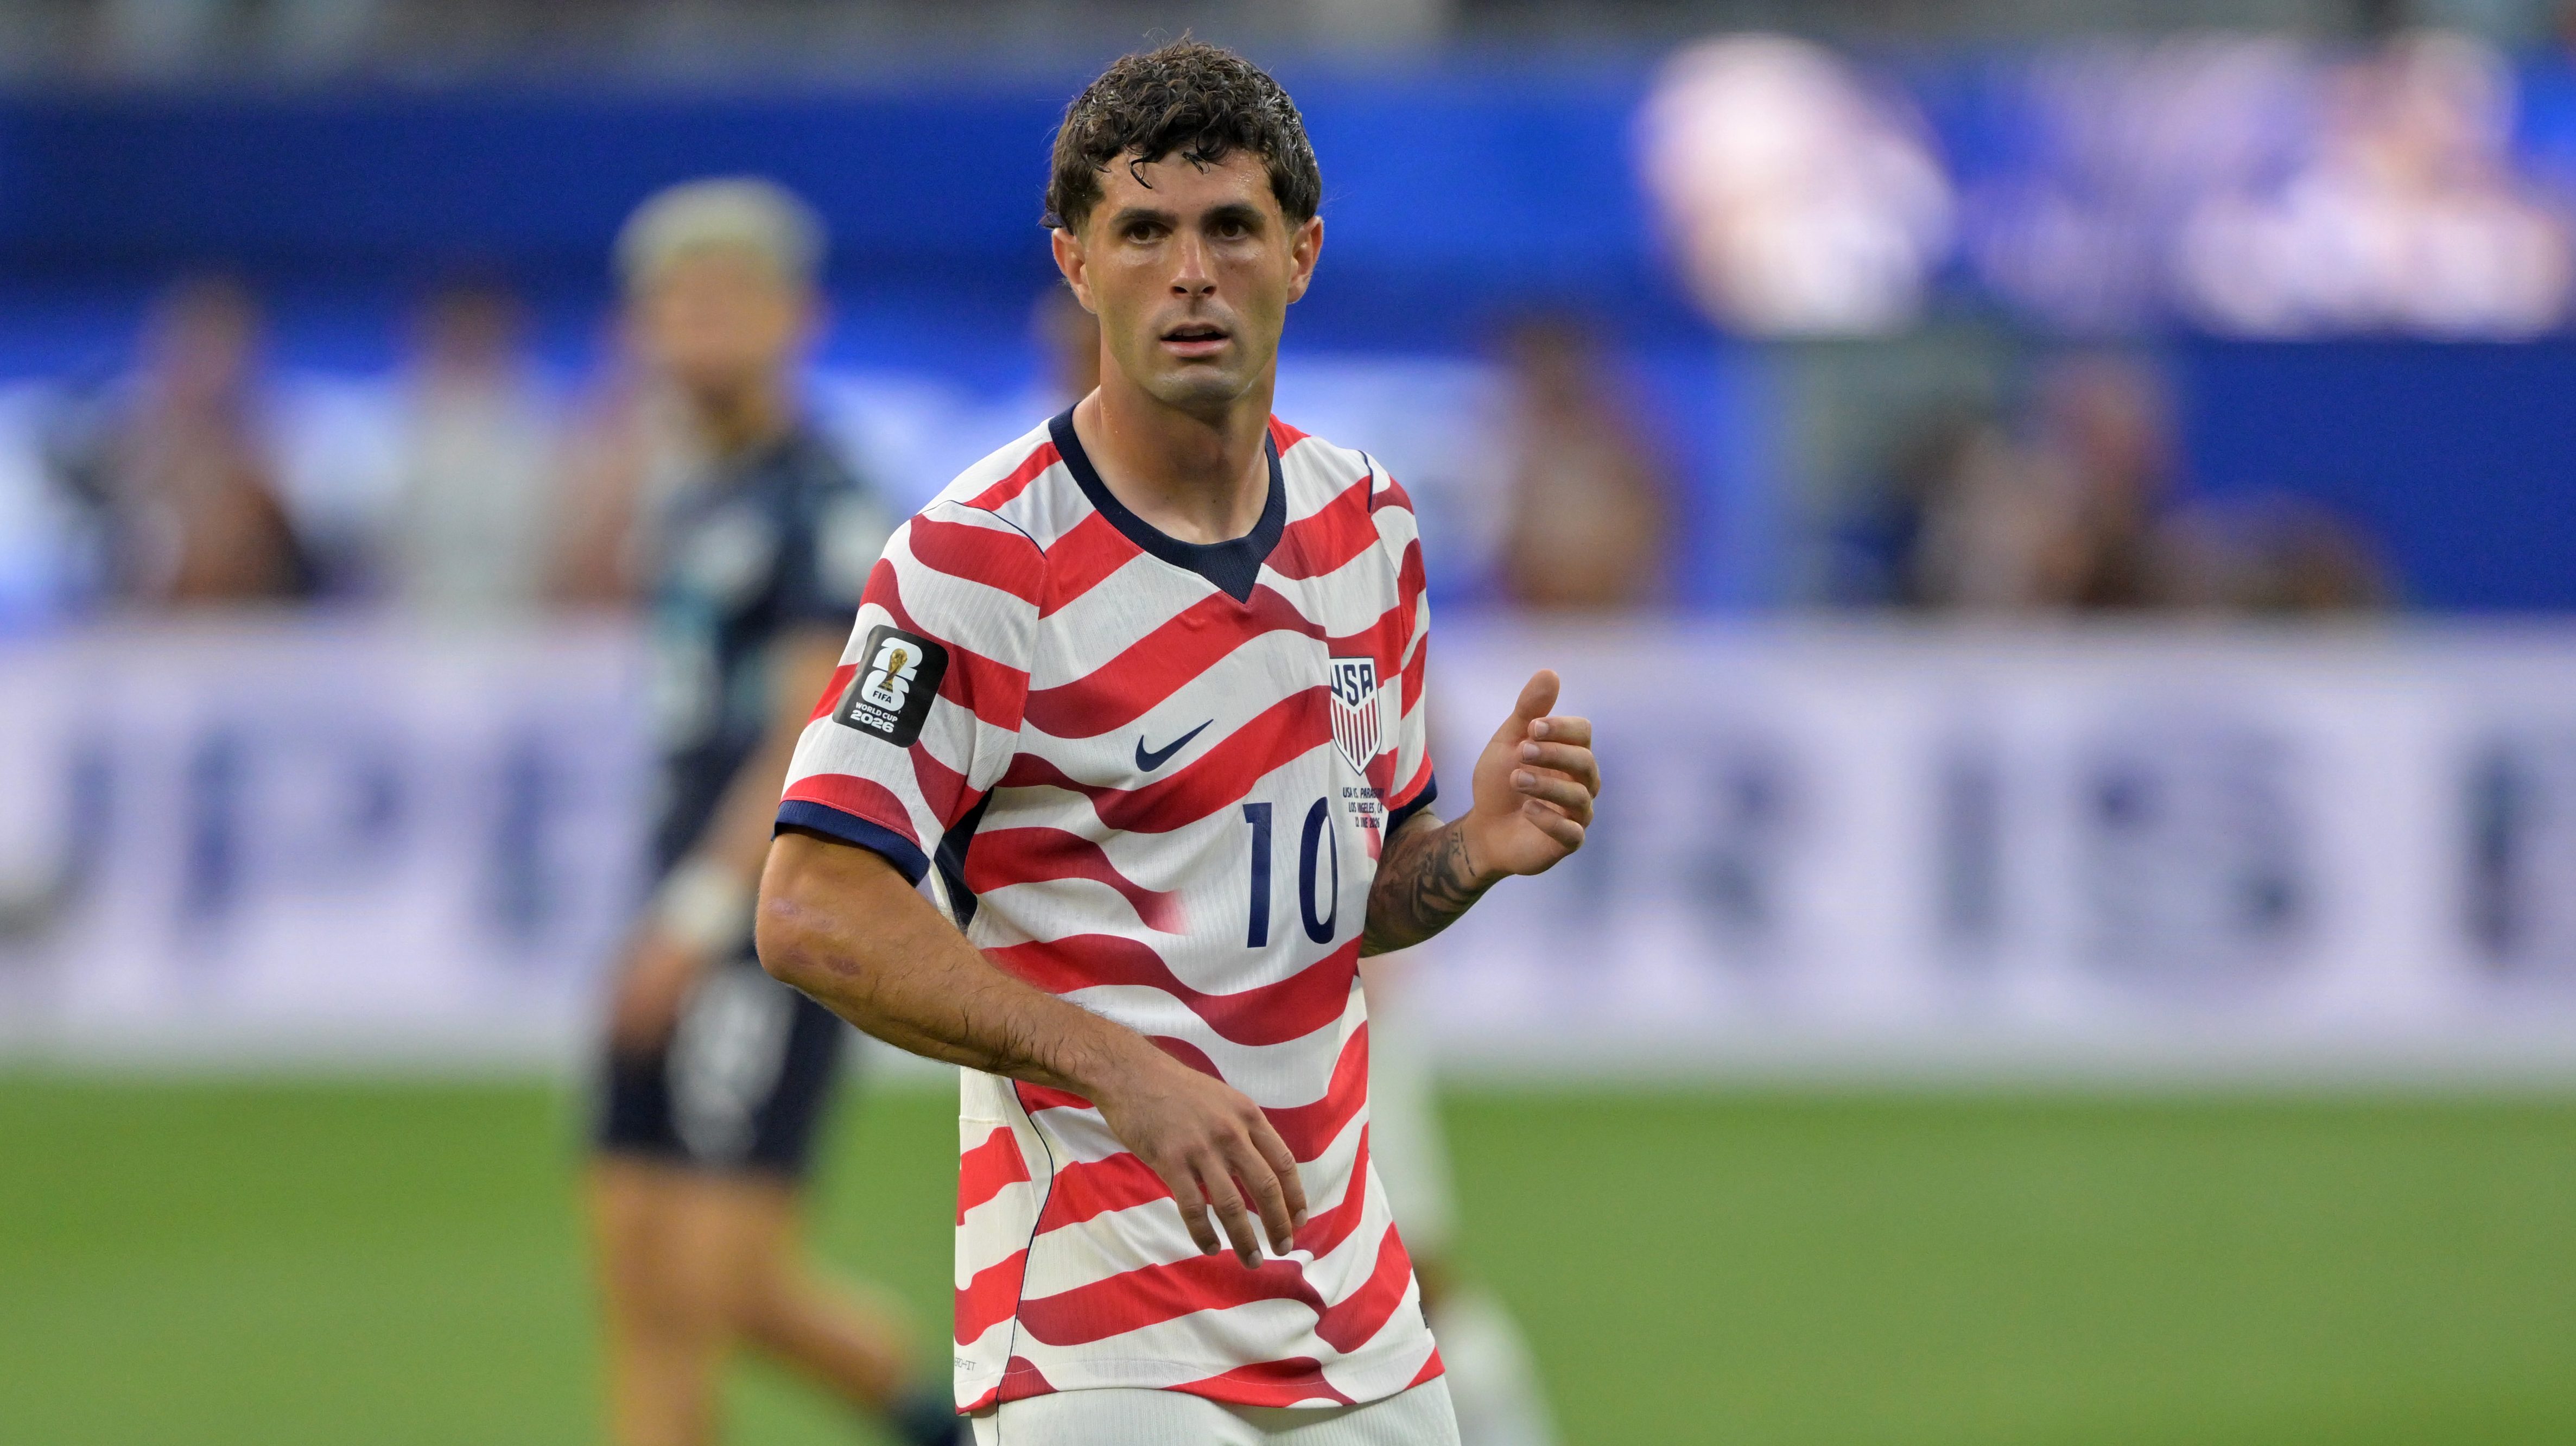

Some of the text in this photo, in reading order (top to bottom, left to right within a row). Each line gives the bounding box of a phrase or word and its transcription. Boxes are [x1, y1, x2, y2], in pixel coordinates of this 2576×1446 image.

[1330, 664, 1373, 707] USA
[872, 690, 891, 703] FIFA
[850, 709, 894, 733] 2026
[855, 702, 898, 722] WORLD CUP
[1343, 787, 1353, 798] USA
[1348, 802, 1356, 813] LOS
[1377, 803, 1383, 813] CA
[1242, 796, 1337, 948] 10
